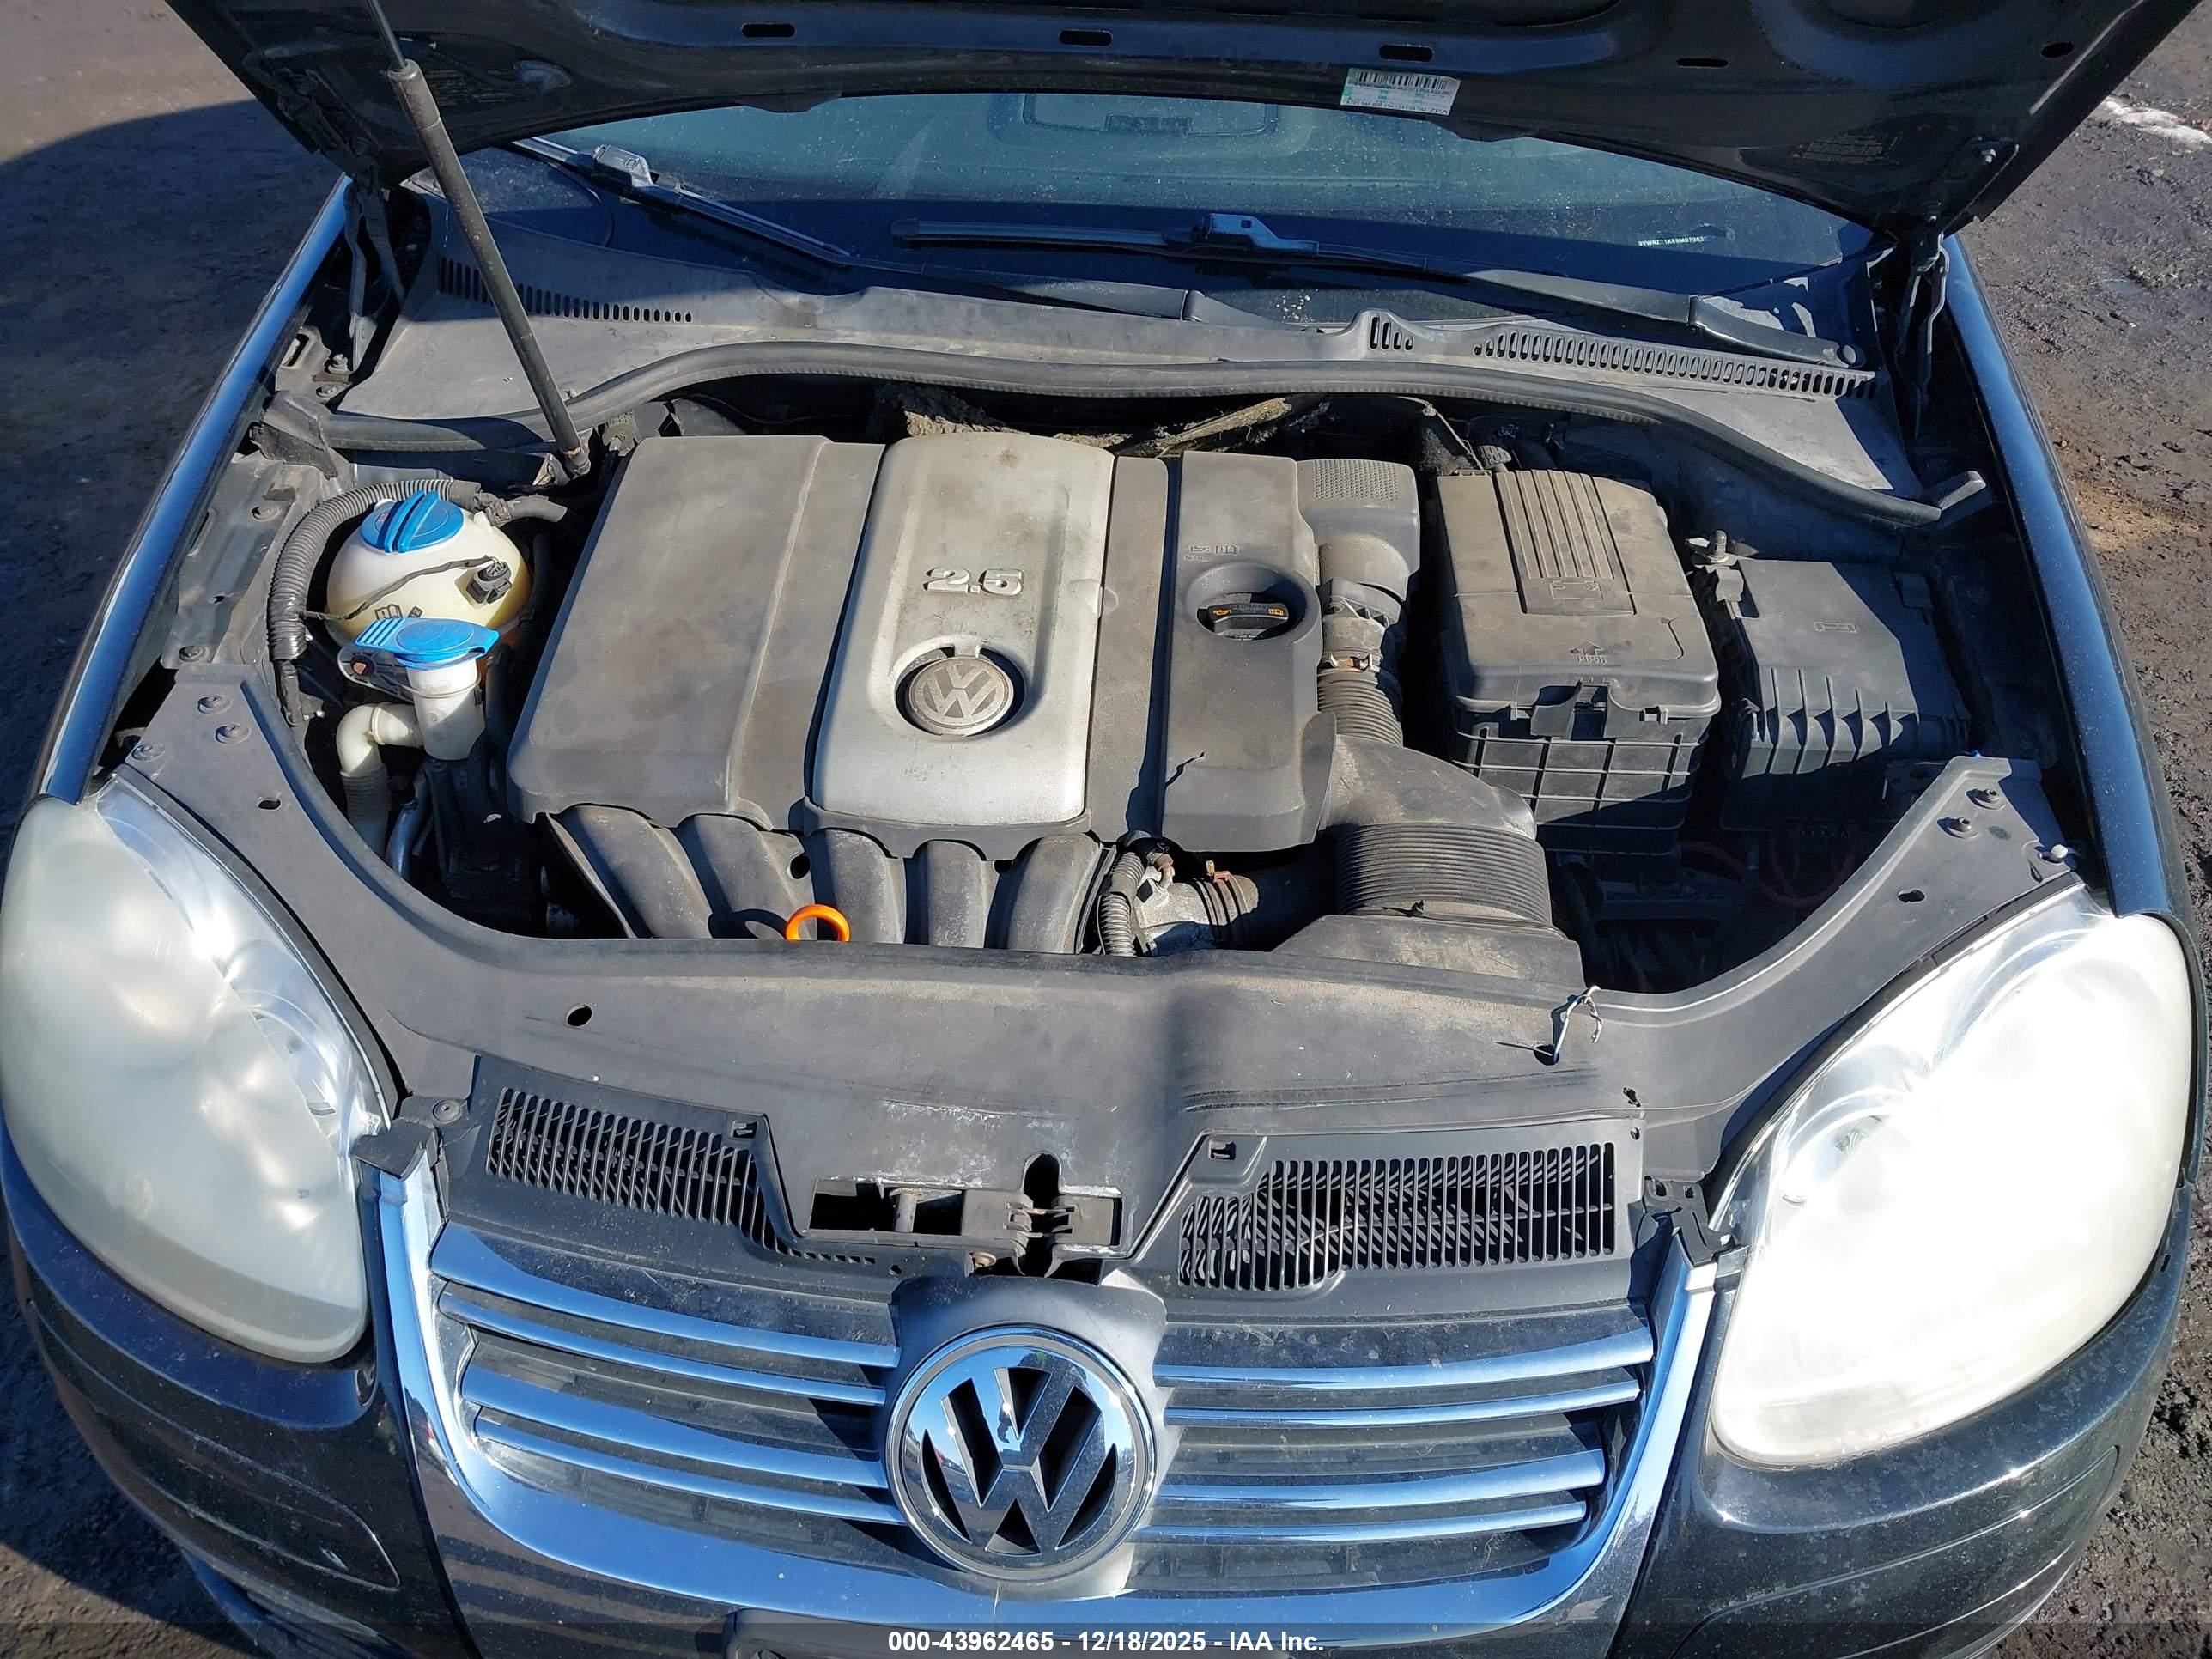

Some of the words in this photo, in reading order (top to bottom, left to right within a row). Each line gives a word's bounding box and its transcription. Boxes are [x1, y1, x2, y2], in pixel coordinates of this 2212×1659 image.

[922, 567, 1024, 597] 2.5
[911, 658, 1011, 728] VW
[900, 1341, 1139, 1571] VW
